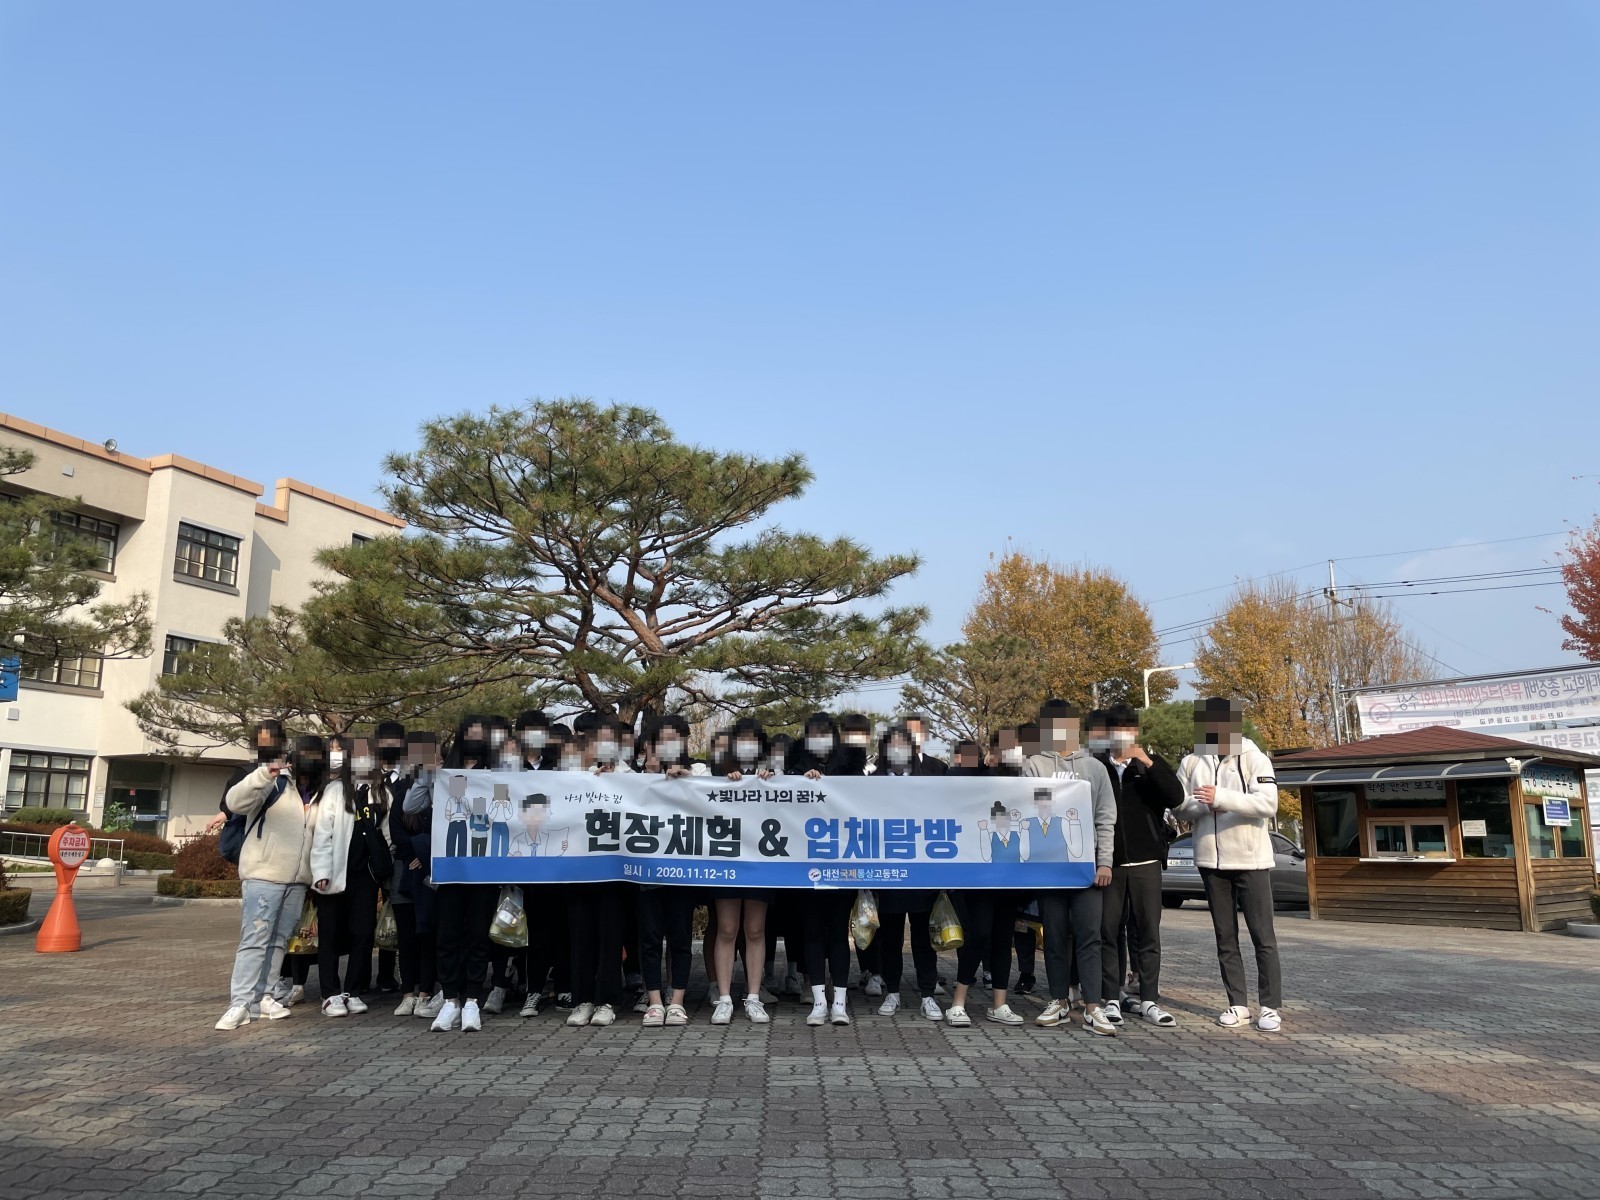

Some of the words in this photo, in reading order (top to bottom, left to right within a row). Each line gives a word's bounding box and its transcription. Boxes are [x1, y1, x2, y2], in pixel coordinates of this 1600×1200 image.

[564, 793, 583, 803] 나의
[719, 789, 762, 803] 빛나라
[765, 789, 793, 803] 나의
[797, 789, 814, 804] 꿈!
[584, 808, 742, 858] 현장체험
[758, 818, 790, 858] &
[804, 817, 962, 860] 업체탐방
[623, 863, 643, 877] 일시
[656, 867, 736, 880] 2020.11.12~13
[822, 868, 909, 879] 대전국제통상고등학교
